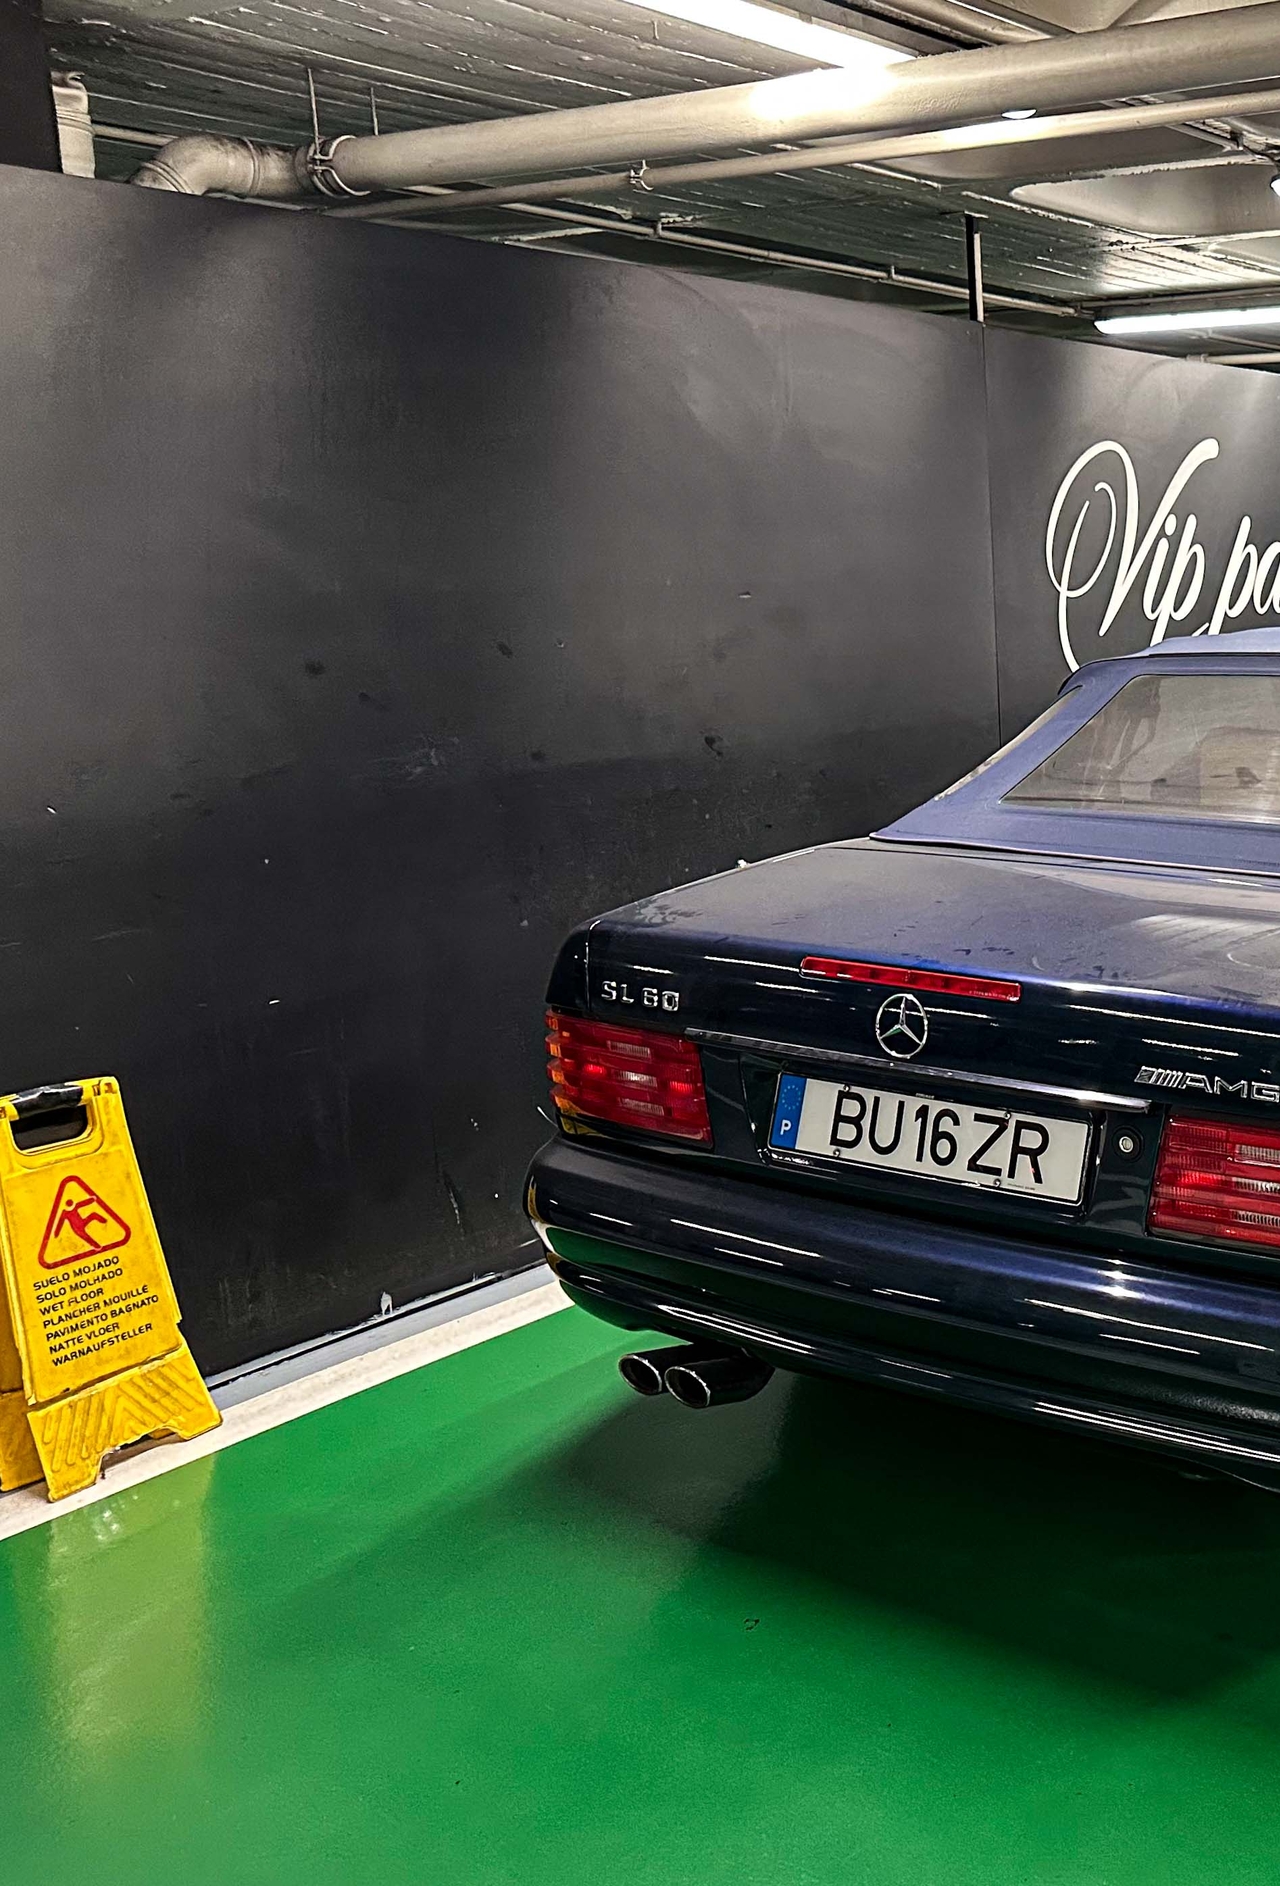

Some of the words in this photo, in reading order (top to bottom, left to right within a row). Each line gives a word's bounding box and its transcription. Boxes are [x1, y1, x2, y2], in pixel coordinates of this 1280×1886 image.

[1045, 438, 1219, 672] Vip
[601, 980, 635, 1004] SL
[642, 987, 680, 1012] 60
[1180, 1071, 1280, 1103] AMG
[780, 1119, 792, 1136] P
[33, 1272, 70, 1291] SUELO
[73, 1255, 120, 1278] MOJADO
[36, 1287, 67, 1304] SOLO
[69, 1268, 123, 1293] MOLHADO
[39, 1301, 65, 1316] WET
[68, 1287, 104, 1307] FLOOR
[43, 1302, 101, 1329] PLANCHER
[46, 1313, 108, 1342] PAVIMENTO
[110, 1295, 159, 1318] BAGNATO
[49, 1336, 84, 1355] NATTE
[85, 1322, 120, 1340] VLOER
[52, 1323, 153, 1367] WARNAUFSTELLER
